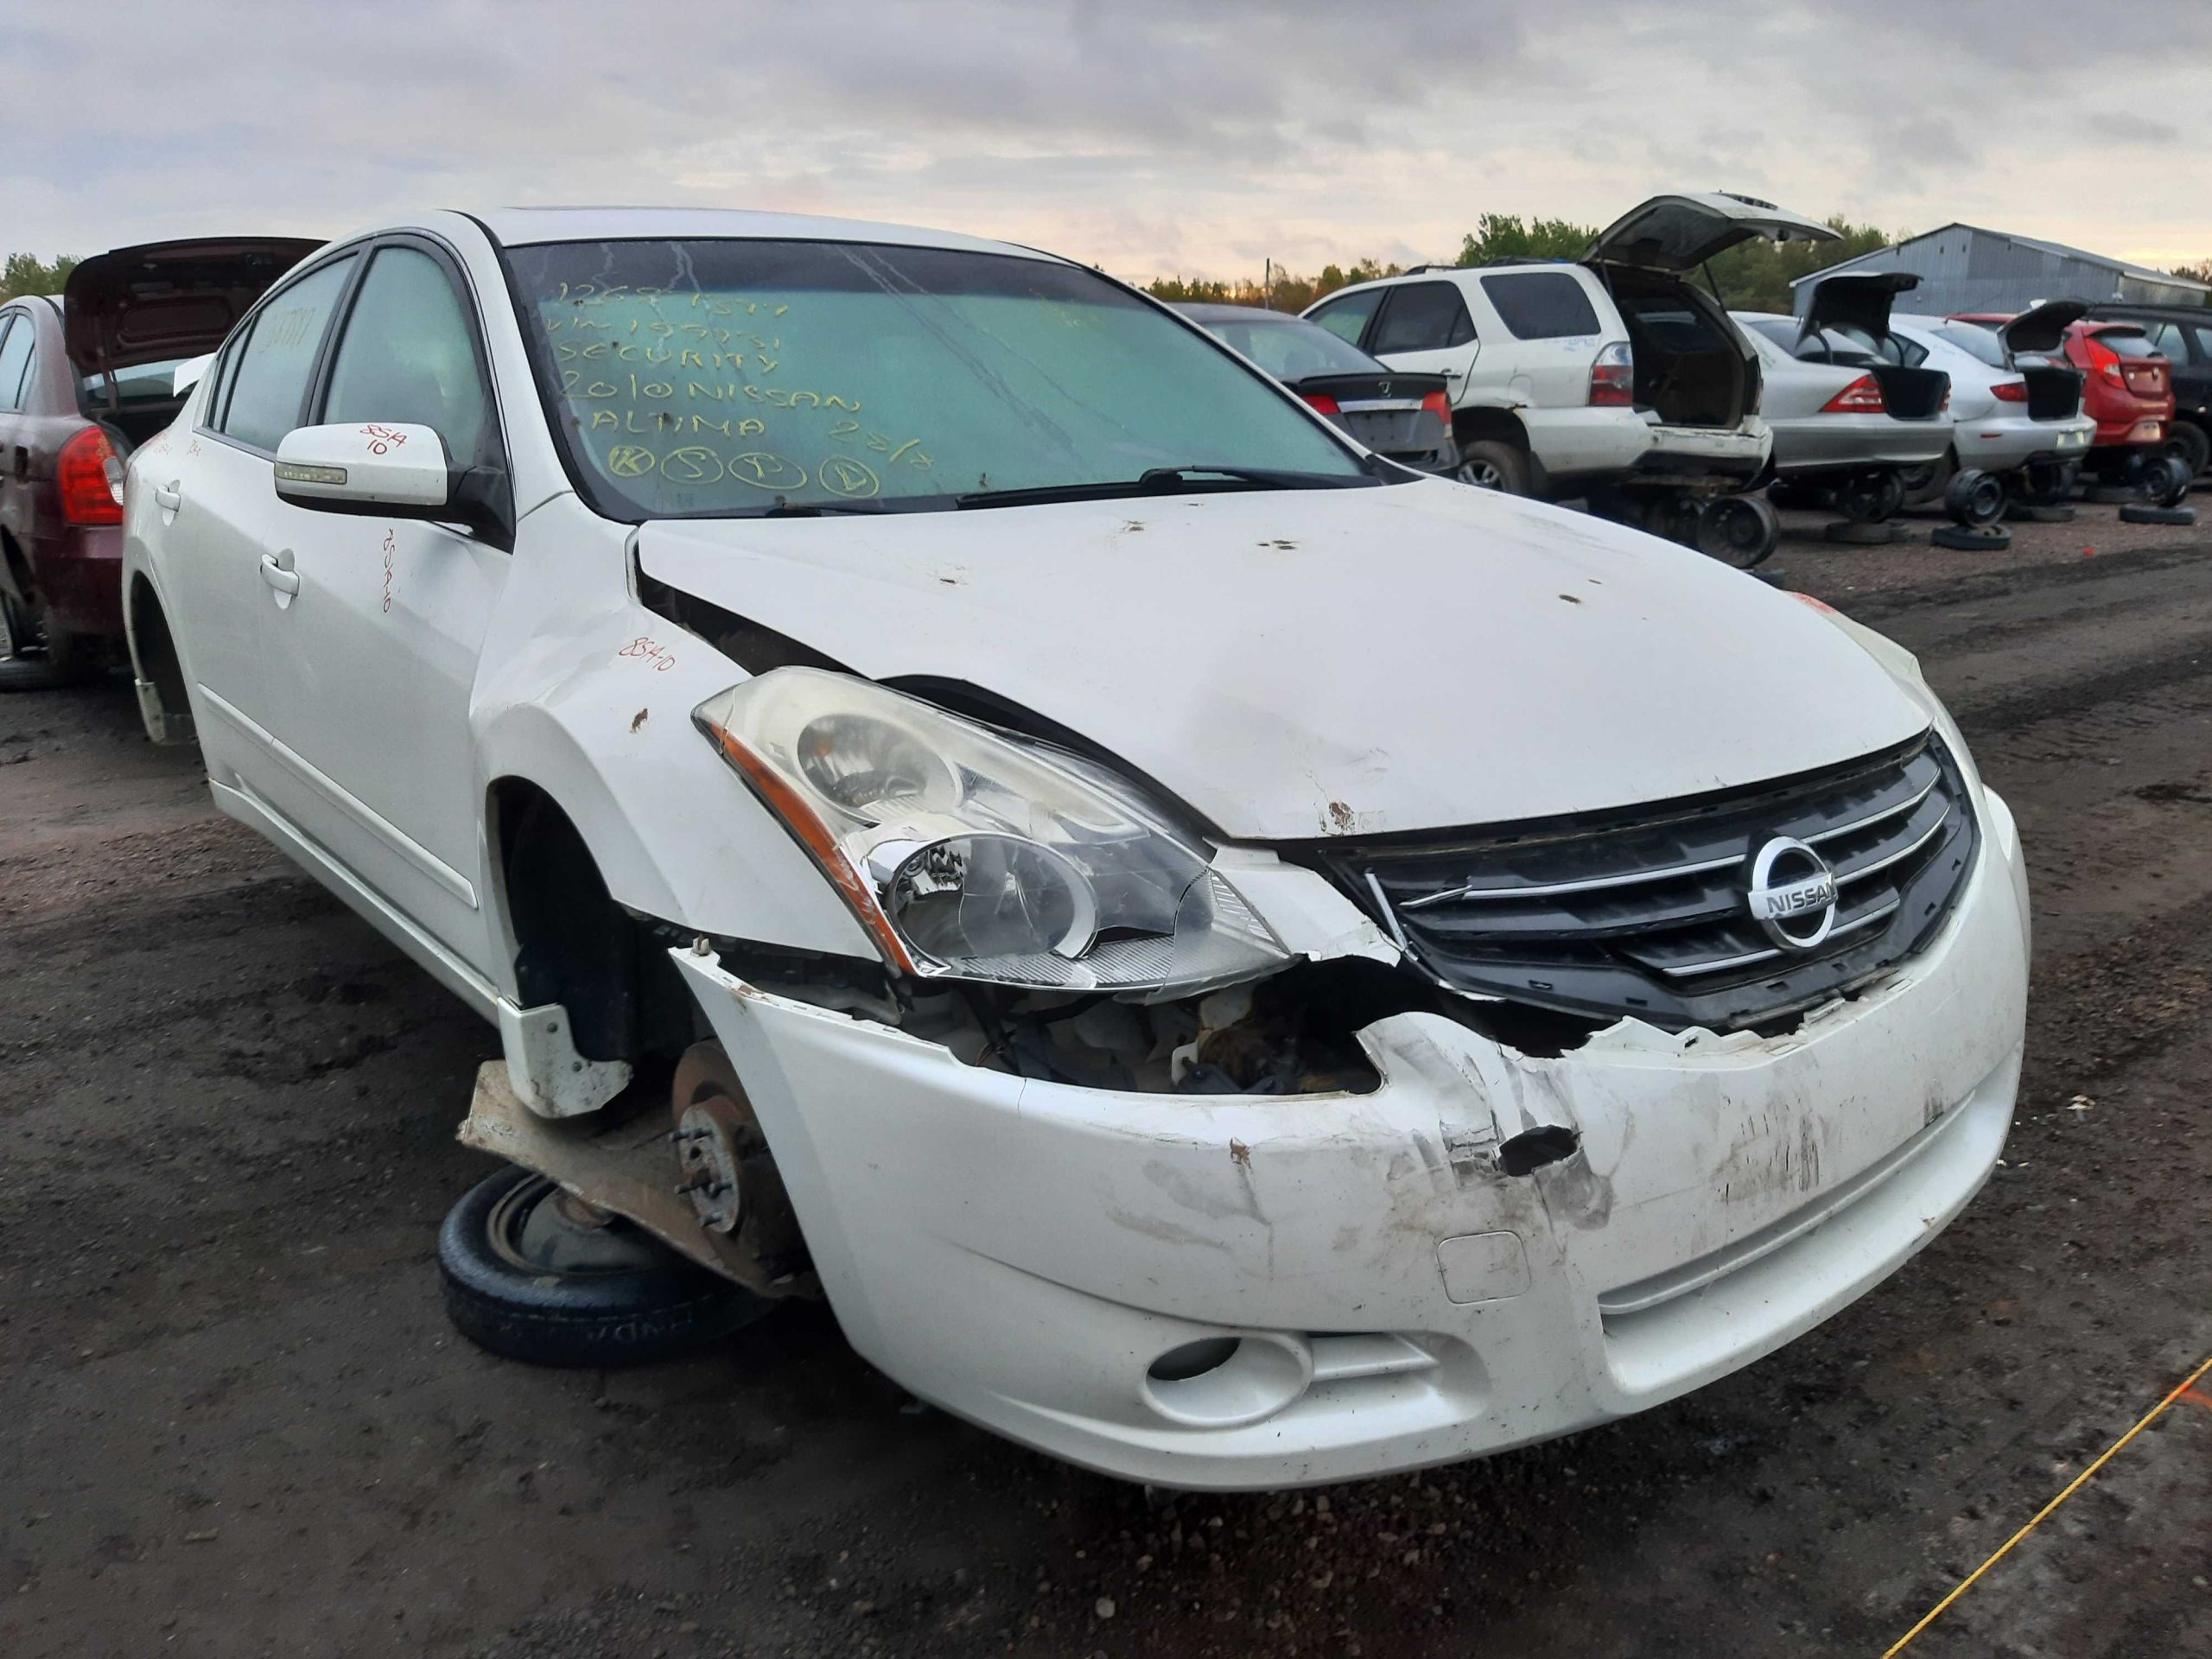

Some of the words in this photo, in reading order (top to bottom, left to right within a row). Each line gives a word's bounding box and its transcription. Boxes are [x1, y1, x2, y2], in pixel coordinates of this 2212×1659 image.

[557, 340, 779, 373] SECURITY
[563, 370, 673, 401] 2010
[689, 380, 861, 412] NISSAN
[591, 410, 766, 437] ALTIMA
[1765, 881, 1838, 914] NISSAN
